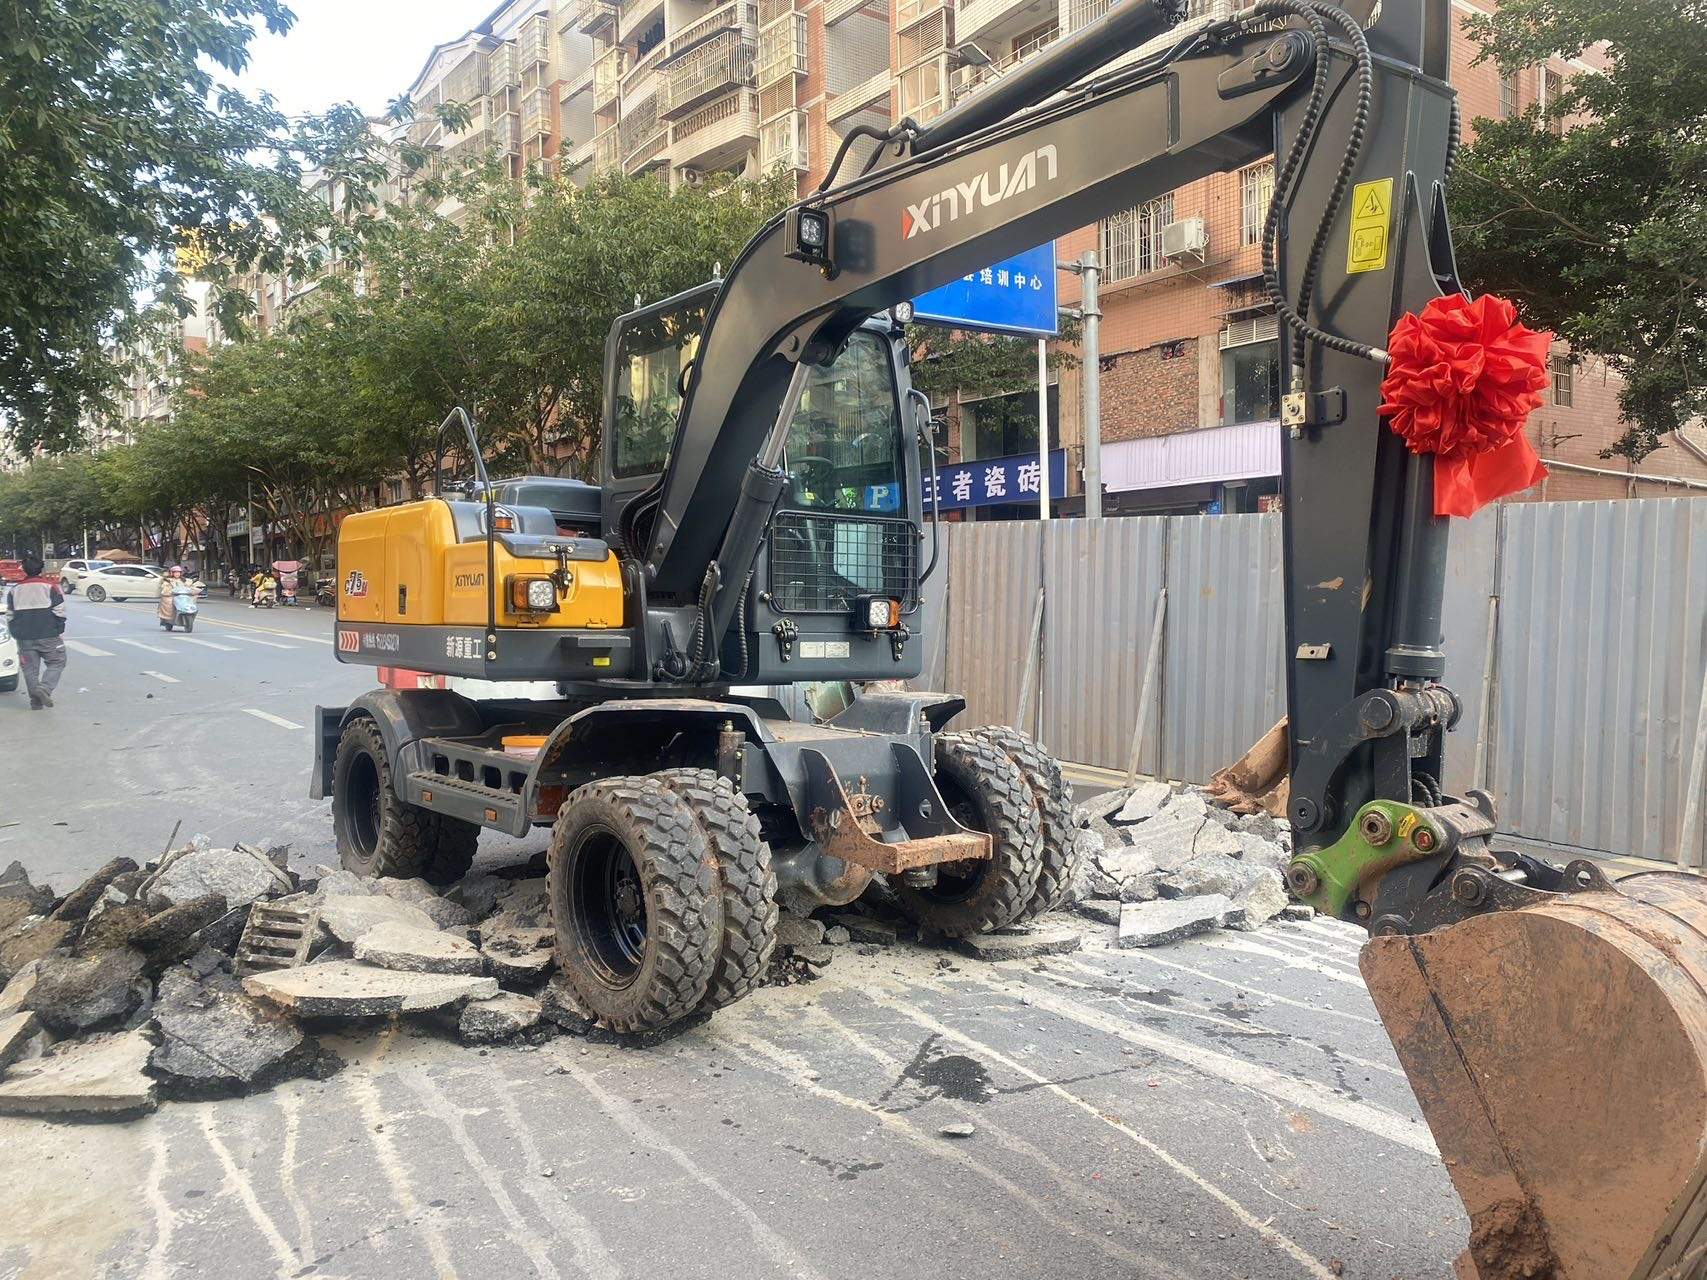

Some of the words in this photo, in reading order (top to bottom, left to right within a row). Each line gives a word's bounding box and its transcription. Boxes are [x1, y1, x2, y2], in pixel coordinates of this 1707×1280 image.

[923, 461, 1041, 502] 王者瓷砖
[446, 635, 482, 659] 新源重工
